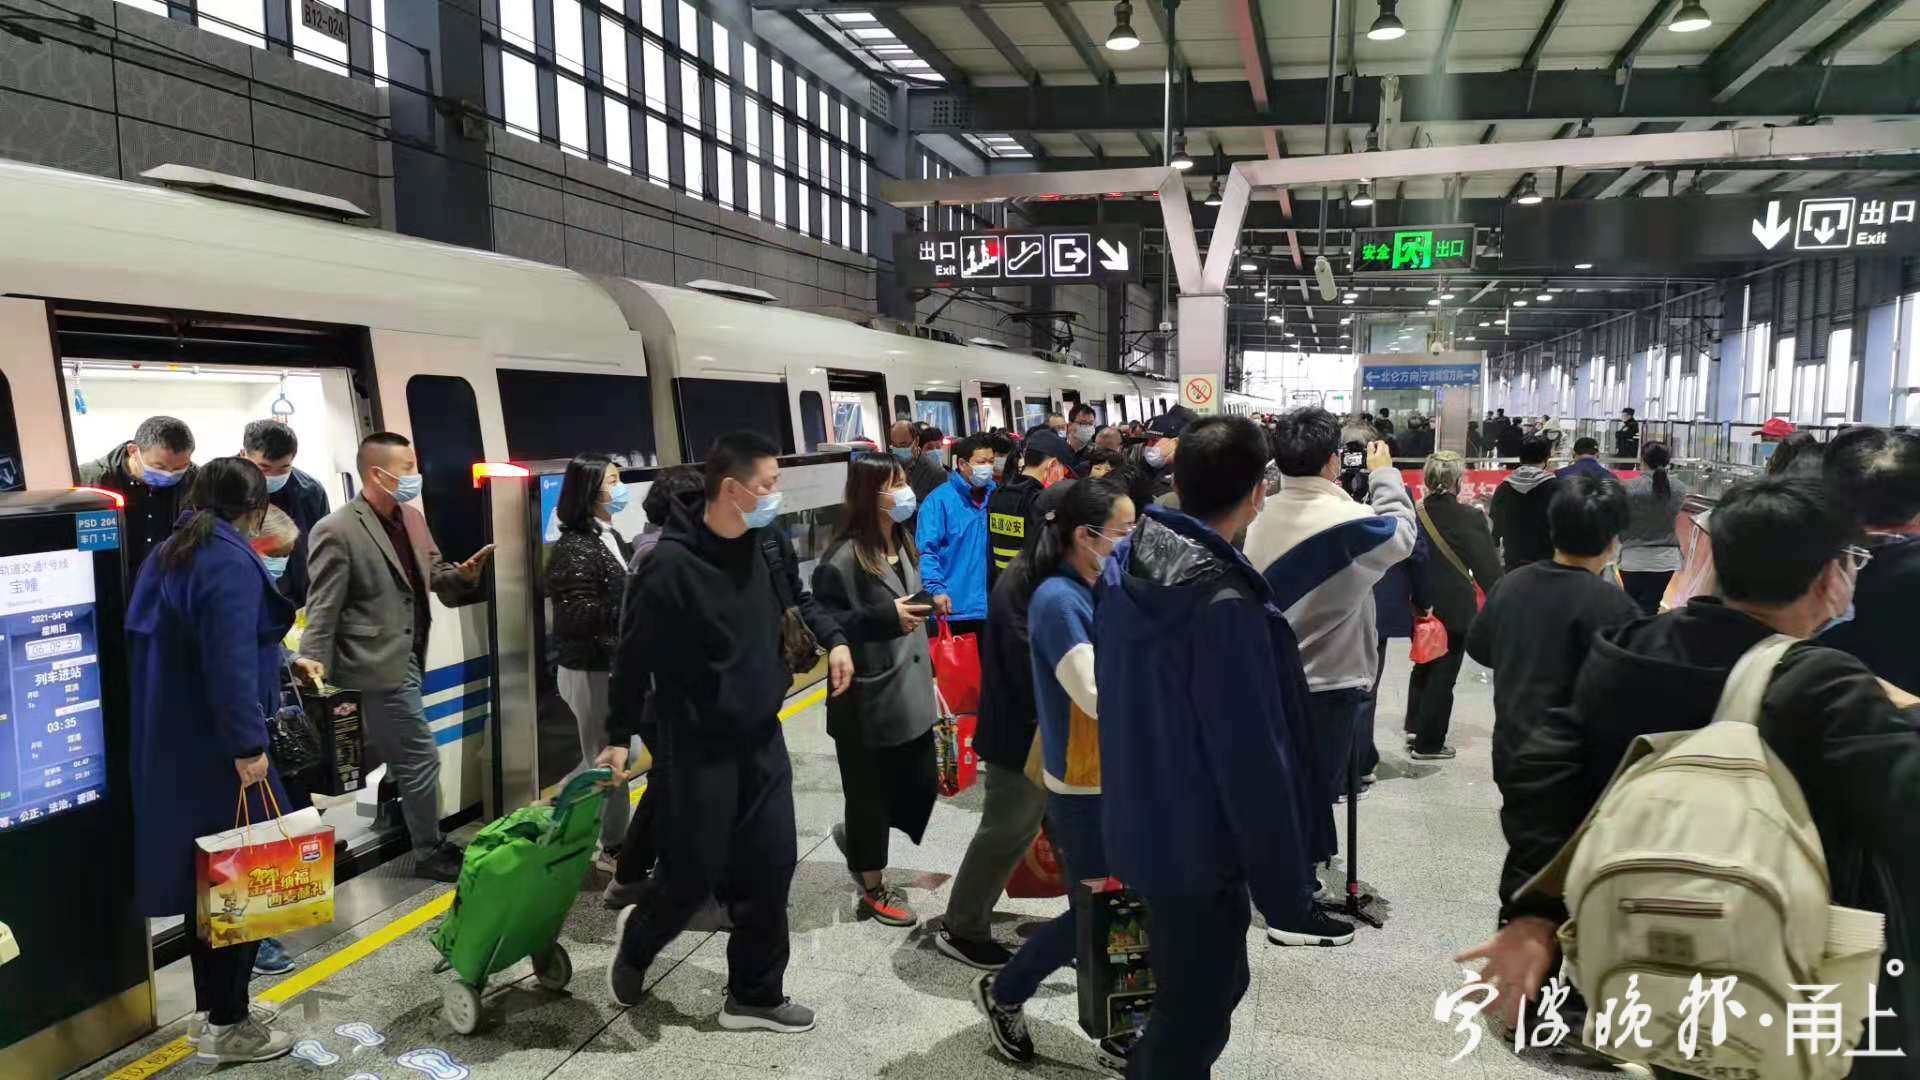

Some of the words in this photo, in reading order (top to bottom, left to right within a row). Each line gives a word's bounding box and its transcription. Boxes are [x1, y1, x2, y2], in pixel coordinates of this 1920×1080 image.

[304, 3, 344, 37] B12-024
[1859, 200, 1916, 225] 出口
[1856, 232, 1888, 245] Exit
[919, 241, 956, 261] 出口
[1362, 243, 1390, 260] 安全
[1435, 239, 1465, 257] 出口
[935, 265, 956, 276] Exit
[78, 518, 97, 529] PSD
[31, 610, 74, 624] 2021-04-04
[41, 622, 67, 636] 星期日
[34, 665, 82, 687] 列车进站
[47, 717, 77, 734] 03:35
